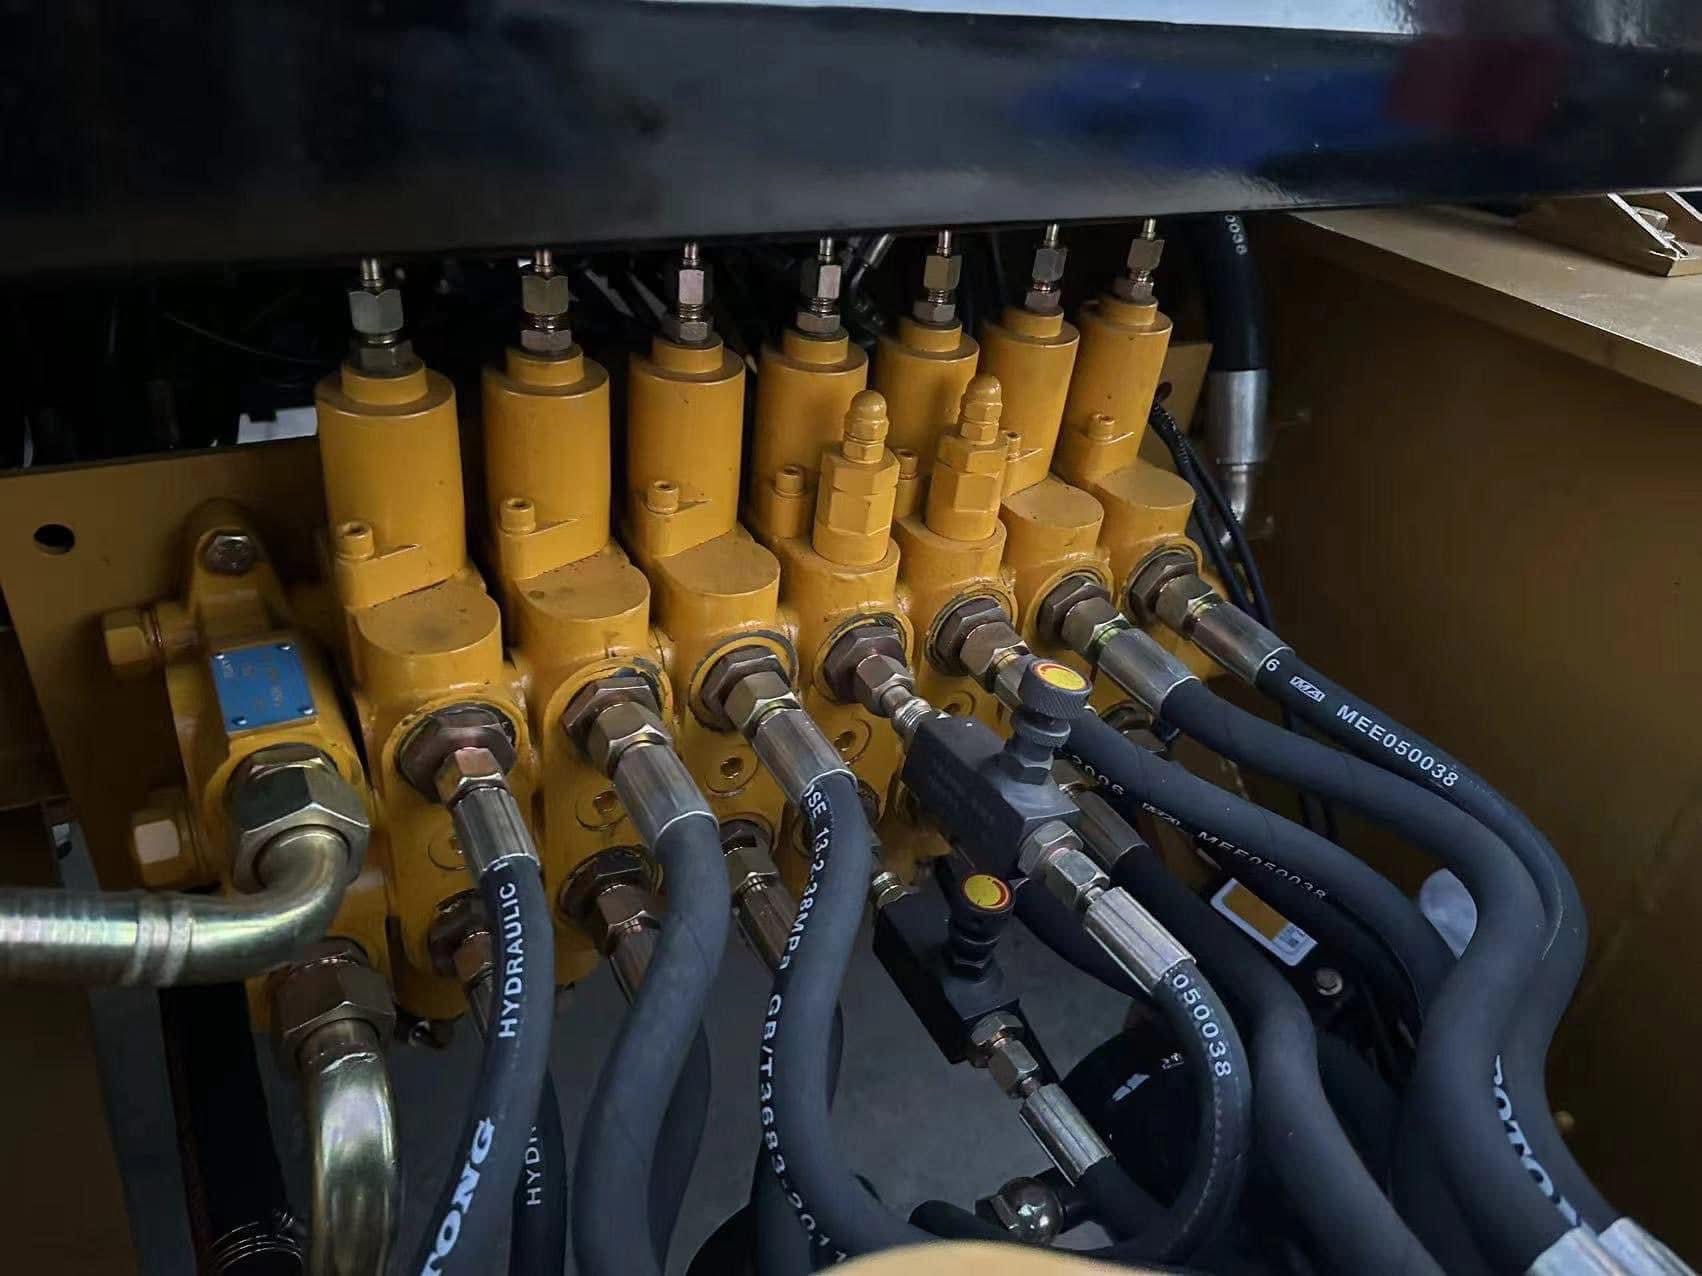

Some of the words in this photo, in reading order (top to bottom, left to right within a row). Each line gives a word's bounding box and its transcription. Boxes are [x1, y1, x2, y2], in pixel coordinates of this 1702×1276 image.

[1335, 703, 1460, 787] MEE050038
[497, 882, 526, 1038] HYDRAULIC
[1171, 973, 1232, 1077] 050038
